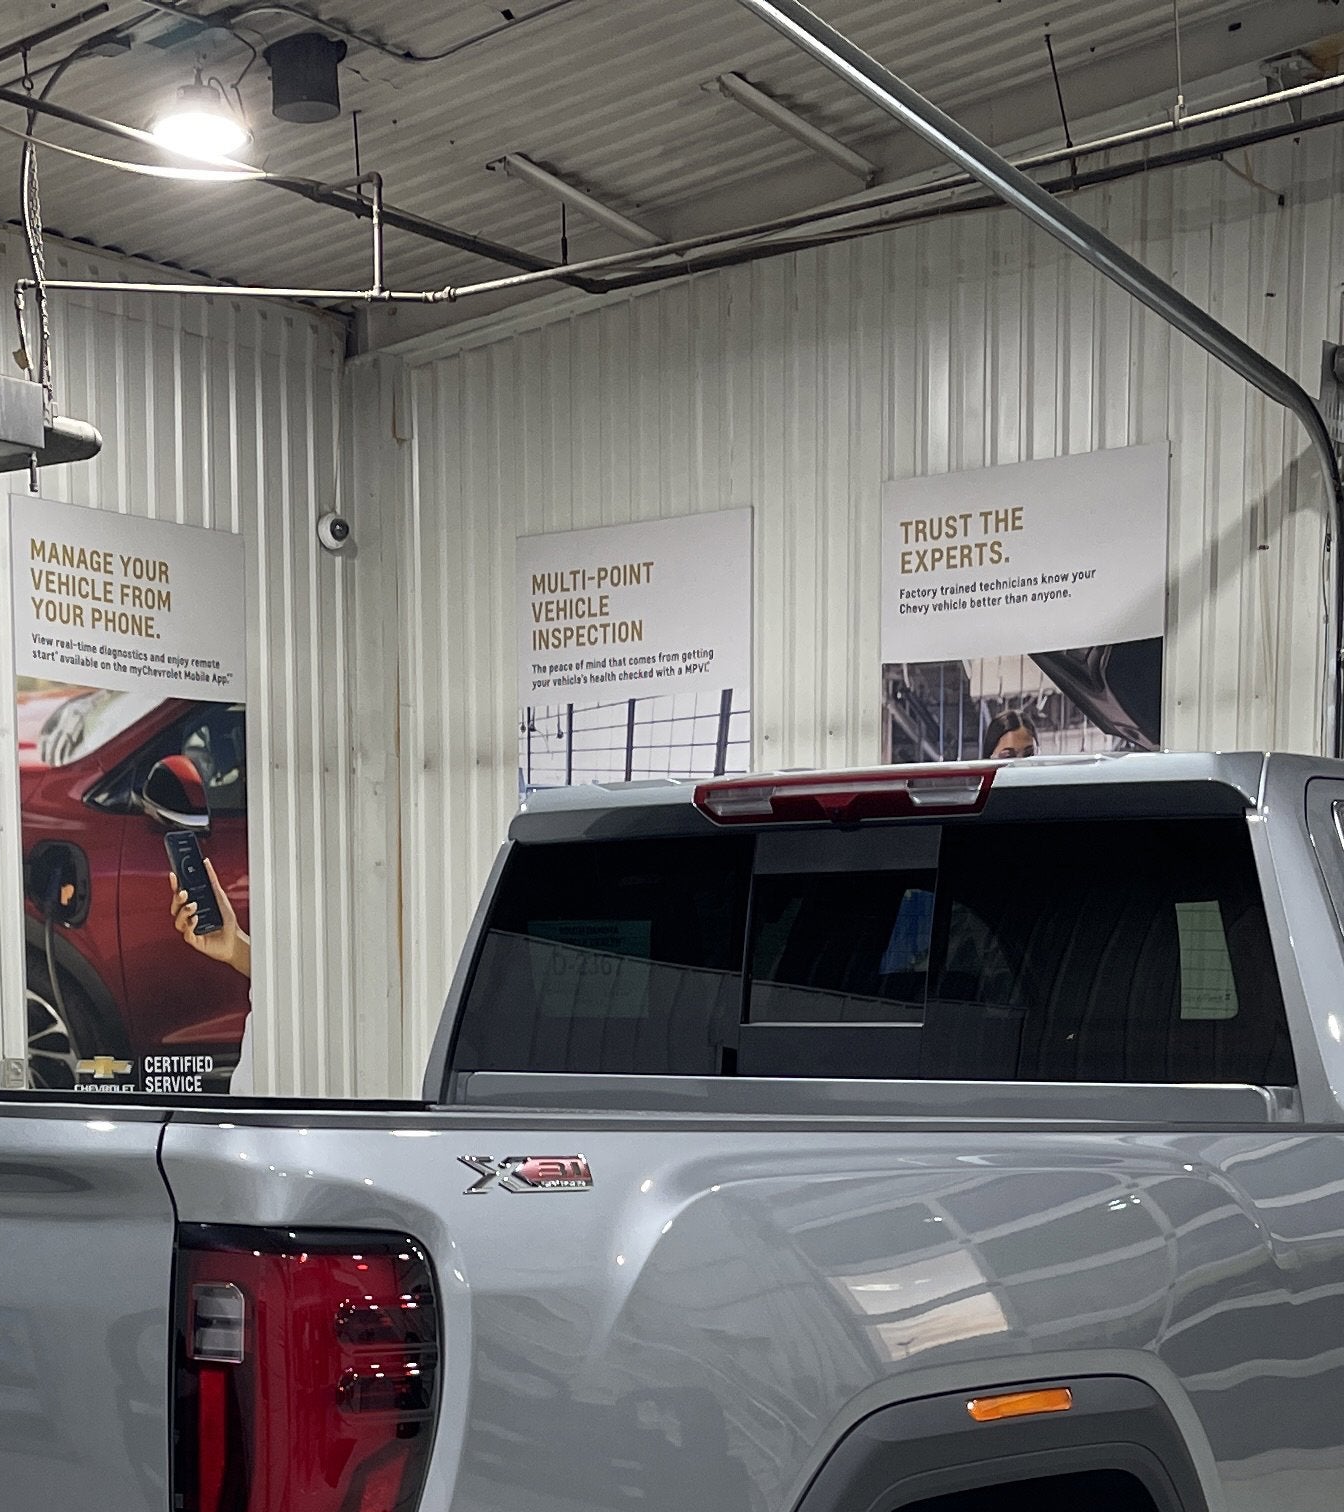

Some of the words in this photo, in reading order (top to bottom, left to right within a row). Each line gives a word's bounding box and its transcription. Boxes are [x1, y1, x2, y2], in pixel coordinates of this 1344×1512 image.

[900, 513, 973, 544] TRUST
[979, 506, 1024, 535] THE
[31, 538, 114, 575] MANAGE
[119, 554, 170, 584] YOUR
[900, 540, 1010, 574] EXPERTS.
[31, 567, 114, 604] VEHICLE
[120, 584, 171, 613] FROM
[532, 561, 654, 595] MULTI-POINT
[899, 588, 938, 599] Factory
[940, 582, 977, 595] trained
[979, 576, 1038, 591] technicians
[1041, 572, 1070, 584] know
[1071, 569, 1096, 583] your
[532, 595, 610, 623] VEHICLE
[899, 603, 930, 615] Chevy
[932, 598, 967, 612] vehicle
[970, 596, 1002, 608] better
[1005, 592, 1028, 604] than
[1030, 588, 1072, 603] anyone.
[31, 597, 84, 628] YOUR
[91, 608, 161, 640] PHONE.
[532, 620, 643, 651] INSPECTION
[31, 632, 54, 646] View
[55, 639, 97, 654] real-time
[99, 645, 148, 661] diagnostics
[150, 653, 165, 663] and
[191, 658, 220, 670] remote
[532, 664, 547, 674] The
[549, 663, 573, 676] peace
[575, 660, 584, 670] of
[586, 658, 607, 669] mind
[608, 657, 626, 667] that
[628, 655, 656, 666] comes
[658, 652, 679, 662] from
[681, 648, 714, 663] getting
[60, 654, 98, 669] available
[100, 661, 112, 670] on
[113, 662, 127, 673] the
[129, 665, 183, 680] myChevrolet
[184, 670, 210, 682] Mobile
[532, 680, 550, 691] your
[589, 671, 617, 683] health
[618, 668, 654, 681] checked
[656, 665, 676, 677] with
[144, 1056, 213, 1073] CERTIFIED
[145, 1076, 203, 1093] SERVICE
